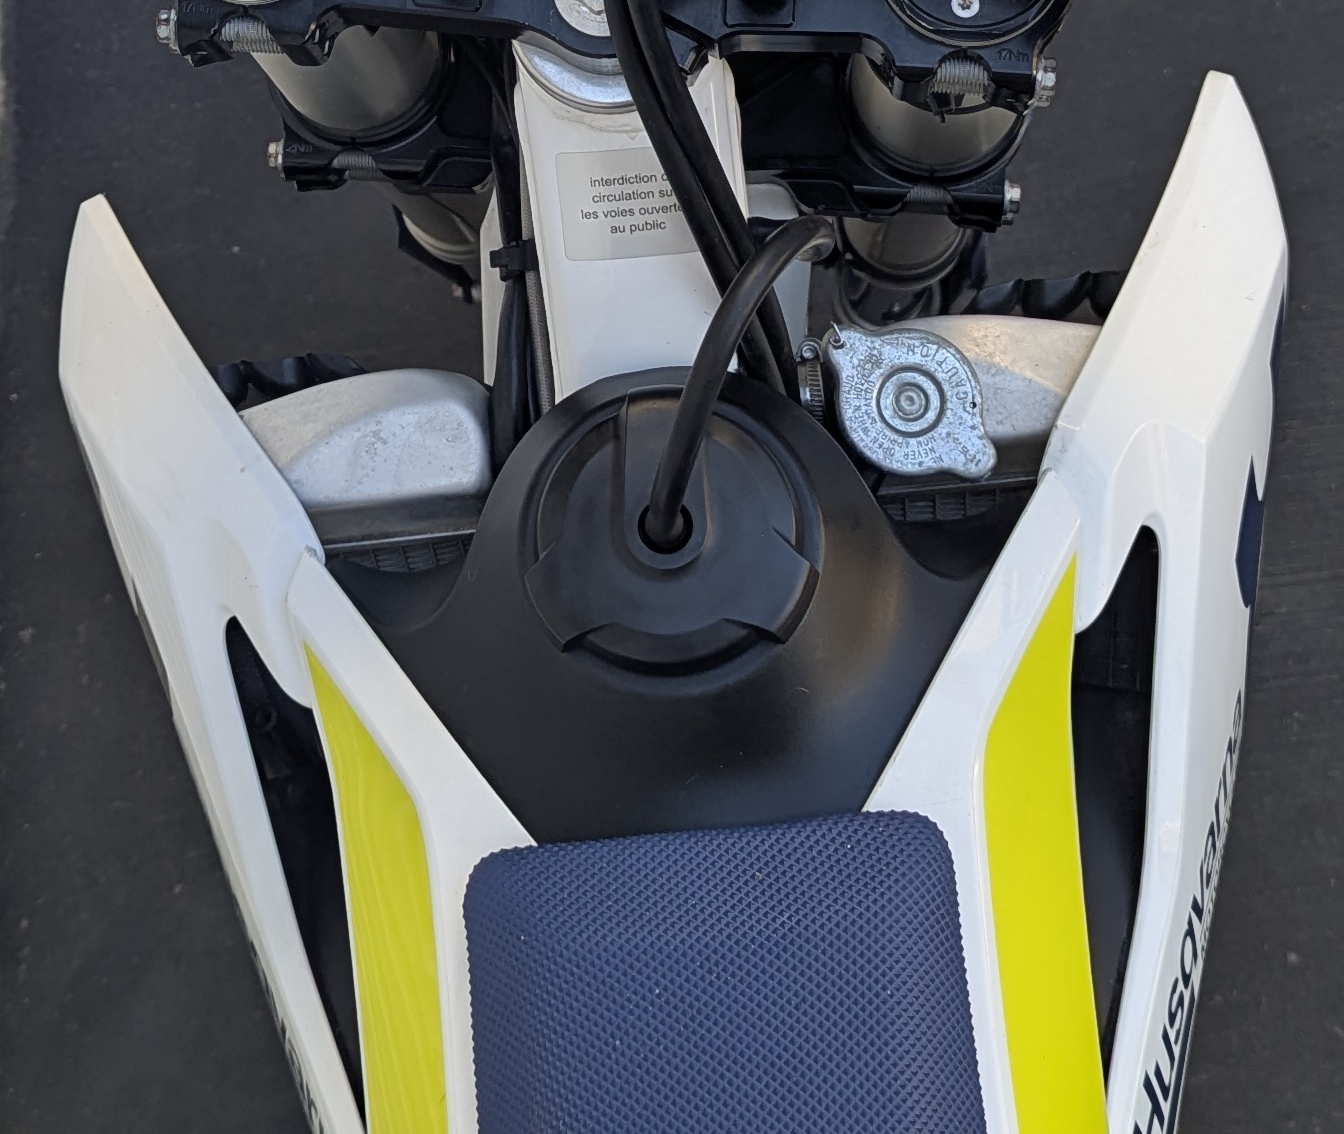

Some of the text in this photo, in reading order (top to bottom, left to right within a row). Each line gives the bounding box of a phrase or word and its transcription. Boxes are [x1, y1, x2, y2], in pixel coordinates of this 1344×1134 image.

[591, 189, 674, 204] circulation su
[580, 202, 683, 220] les voies ouvert
[610, 219, 667, 235] au public
